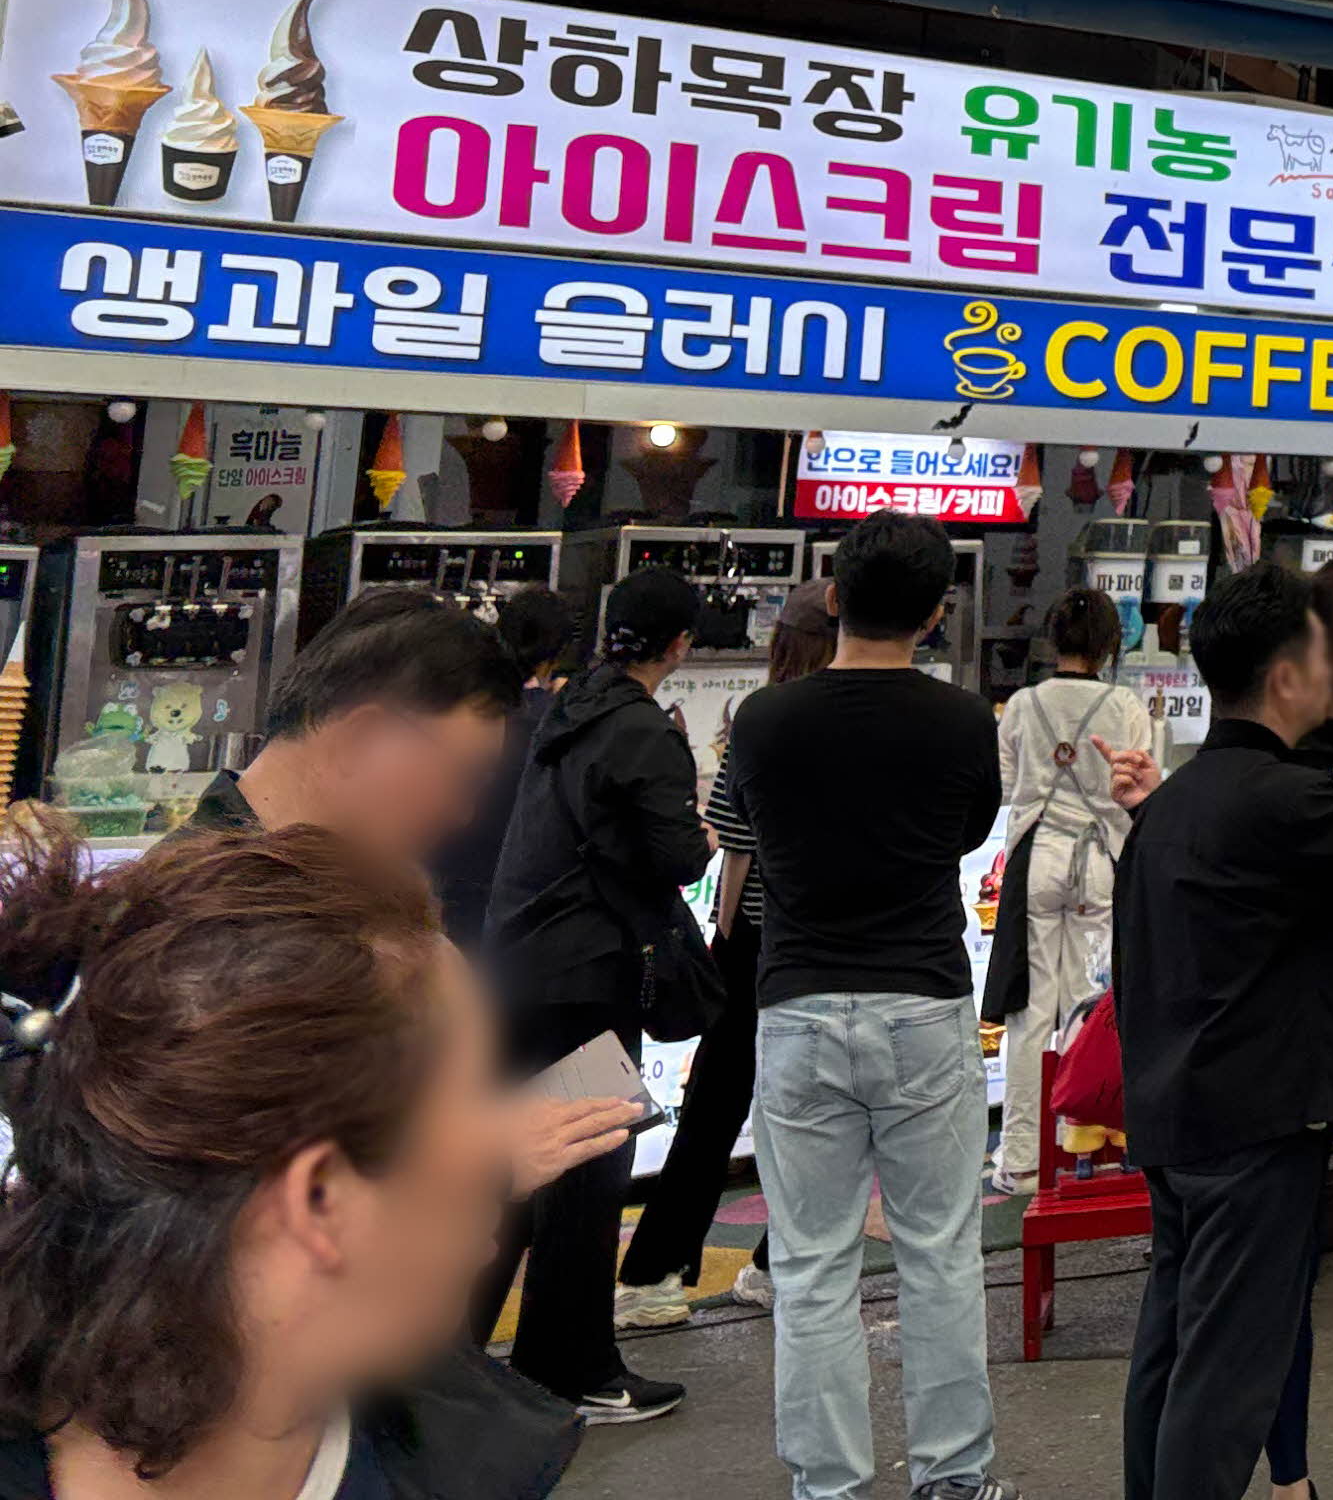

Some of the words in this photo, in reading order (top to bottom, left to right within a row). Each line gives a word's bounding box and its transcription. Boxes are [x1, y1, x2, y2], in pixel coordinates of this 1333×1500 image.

[403, 8, 915, 142] 상하목장
[960, 85, 1237, 182] 유기농
[392, 115, 1043, 275] 아이스크림
[60, 242, 488, 361] 생과일
[534, 279, 885, 382] 슬러시
[229, 429, 302, 462] 흑마늘
[218, 469, 243, 488] 단양
[245, 466, 307, 488] 아이스크림
[807, 446, 881, 474] 안으로
[890, 450, 1021, 479] 들어오세요!
[814, 484, 1005, 517] 아이스크림/커피
